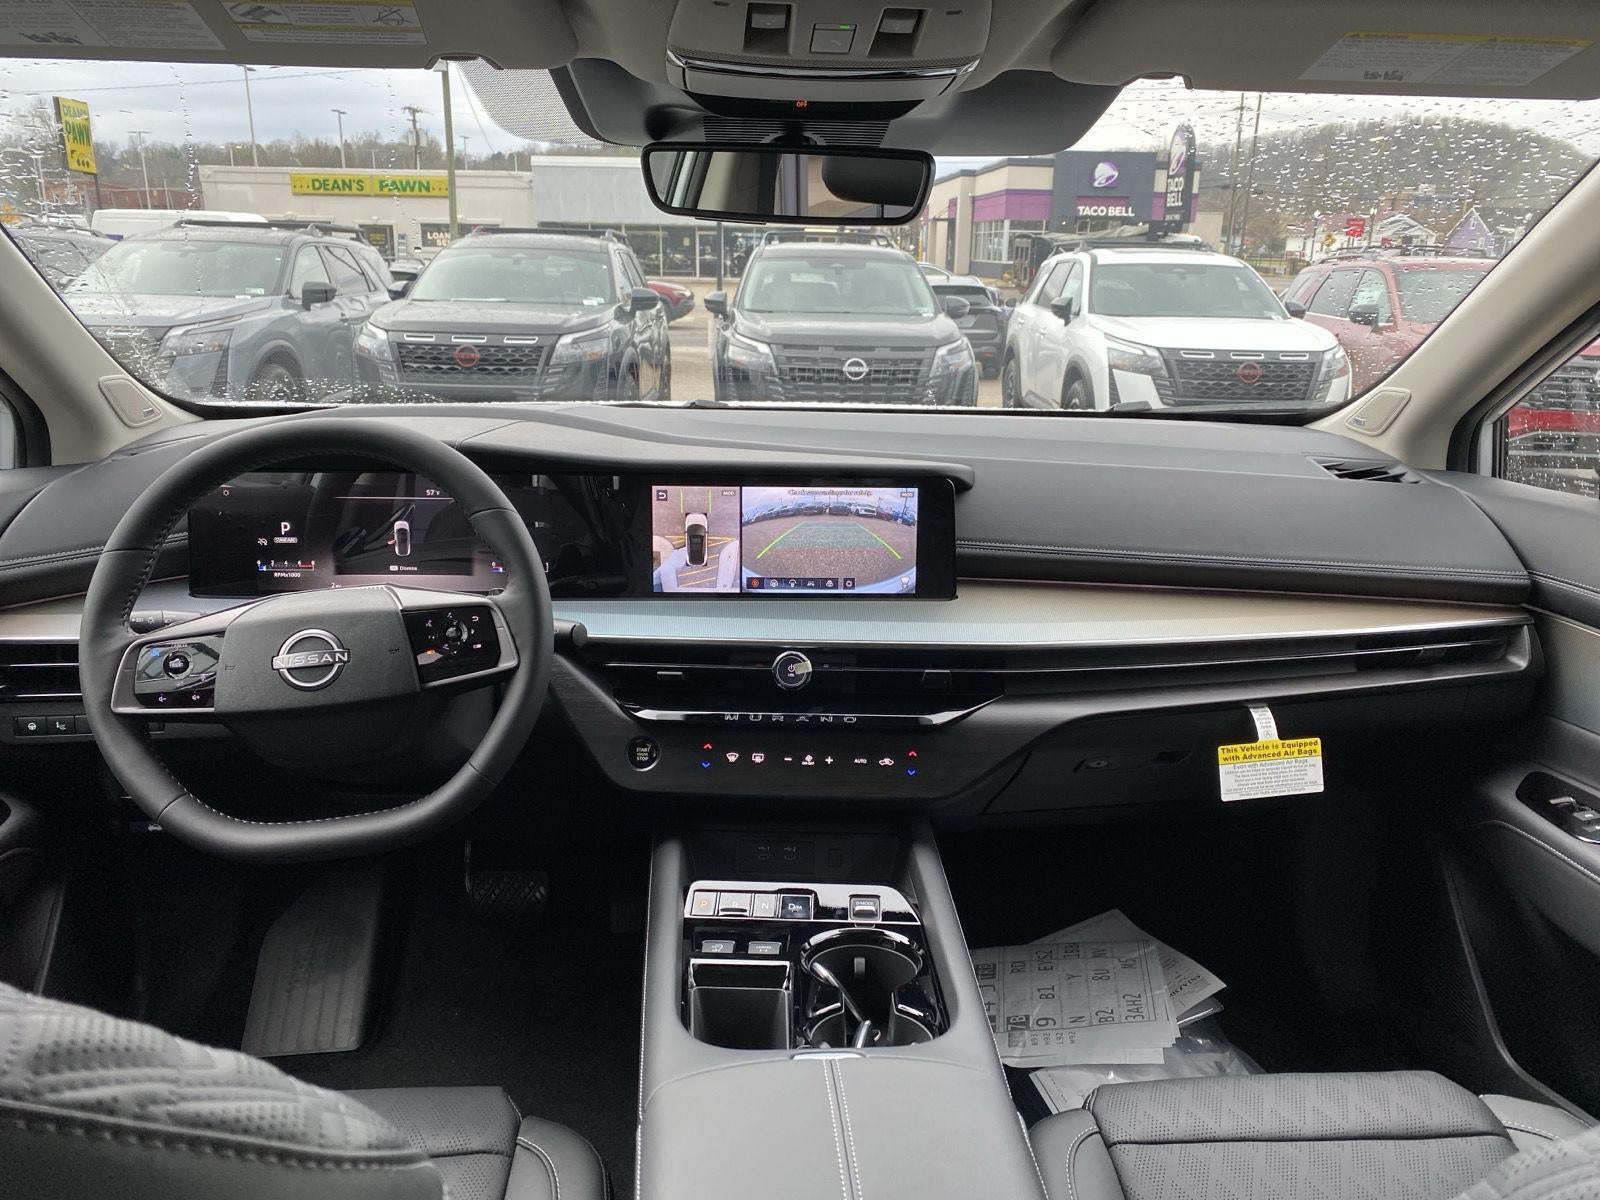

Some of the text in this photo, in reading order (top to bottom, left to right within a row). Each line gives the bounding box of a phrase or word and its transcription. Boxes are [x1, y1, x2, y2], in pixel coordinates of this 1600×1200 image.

[311, 178, 431, 193] DEAN'S PAWN
[1166, 192, 1183, 207] BELL
[1077, 205, 1135, 217] TACO BELL
[280, 521, 291, 536] P
[275, 652, 348, 668] NISSAN
[724, 712, 857, 723] MURANO
[1220, 747, 1238, 755] This
[1240, 744, 1270, 753] Vehicle
[1281, 740, 1319, 750] Equipped
[1222, 748, 1318, 762] with Advanced Air Bags
[761, 902, 769, 910] N
[1065, 972, 1082, 981] Y
[1122, 993, 1145, 1021] 3AH2
[1068, 1014, 1086, 1024] N
[1095, 1008, 1115, 1023] B2
